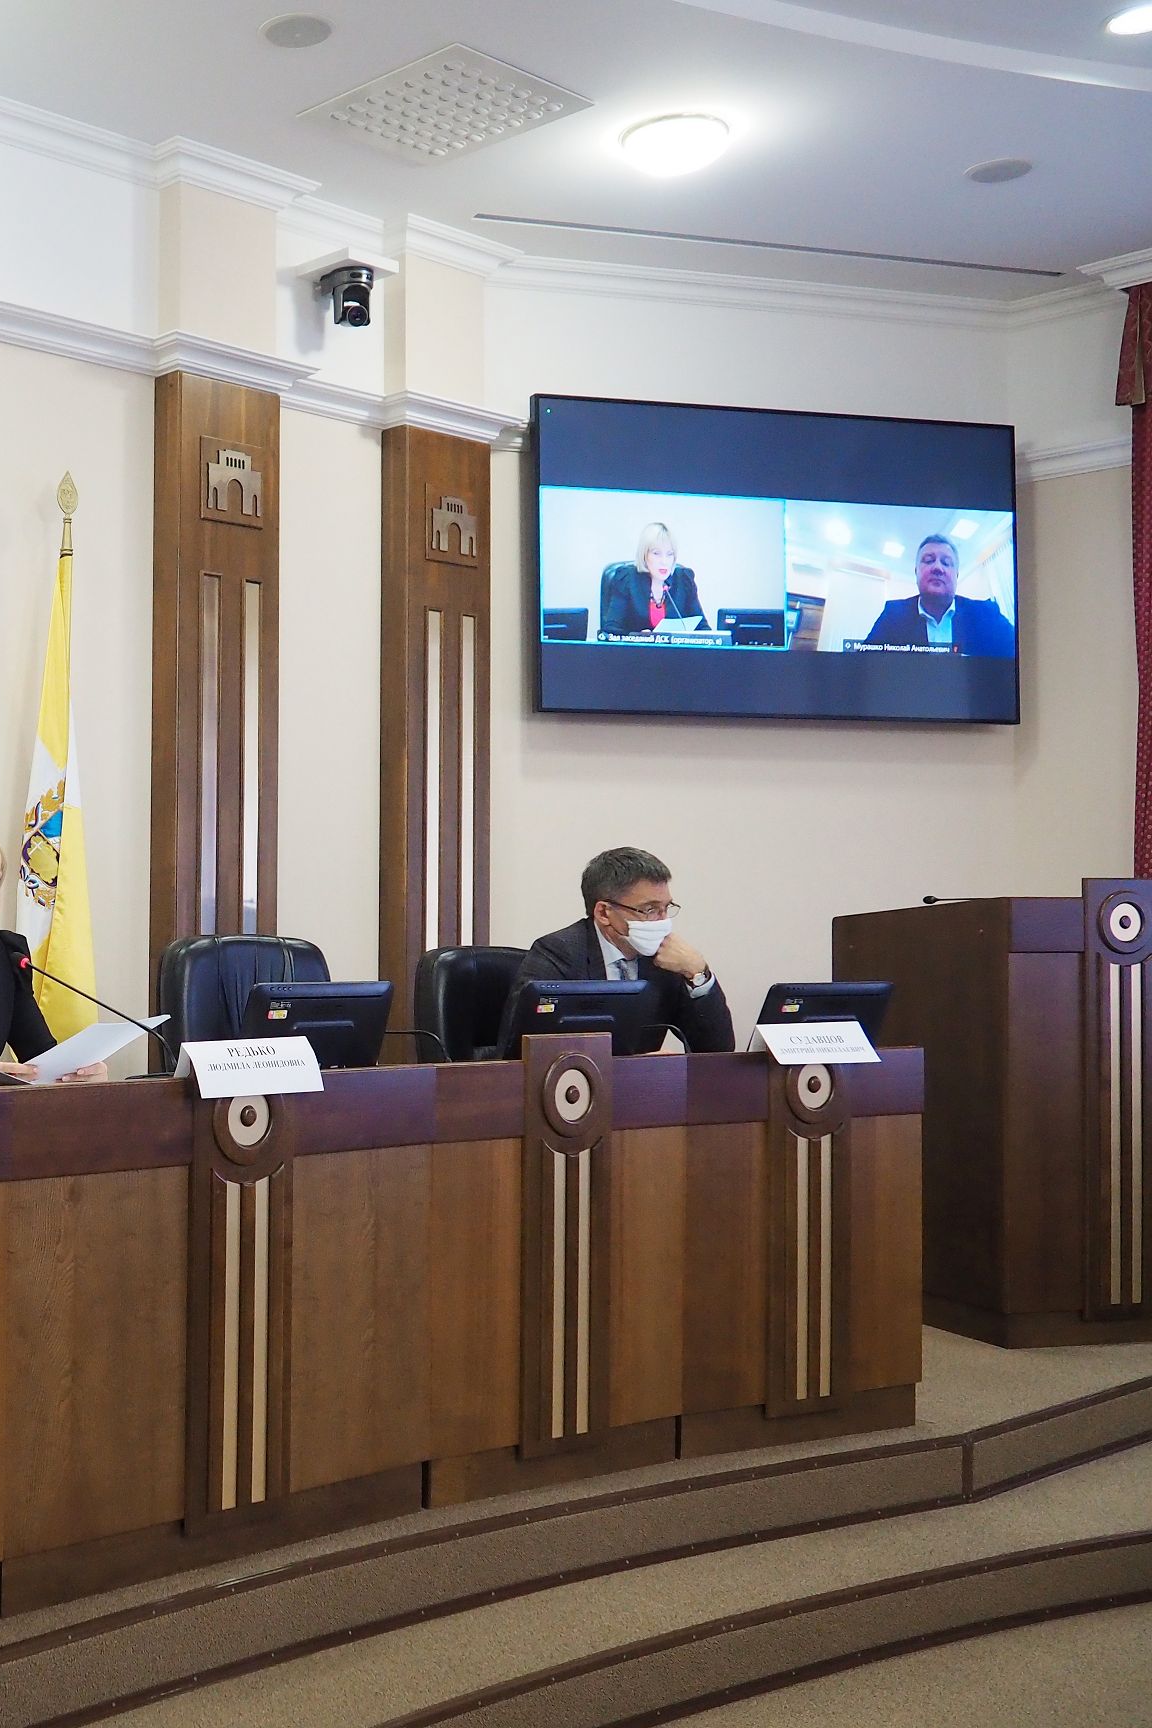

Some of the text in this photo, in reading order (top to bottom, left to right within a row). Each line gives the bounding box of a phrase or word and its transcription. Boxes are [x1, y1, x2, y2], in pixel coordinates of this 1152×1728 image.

[608, 633, 621, 641] Зал
[853, 642, 950, 653] Мурашко Николай Анатольевич
[227, 1045, 276, 1058] РЕДЬКО
[208, 1059, 306, 1072] ЛЮДМИЛА ЛЕОНИДОВНА
